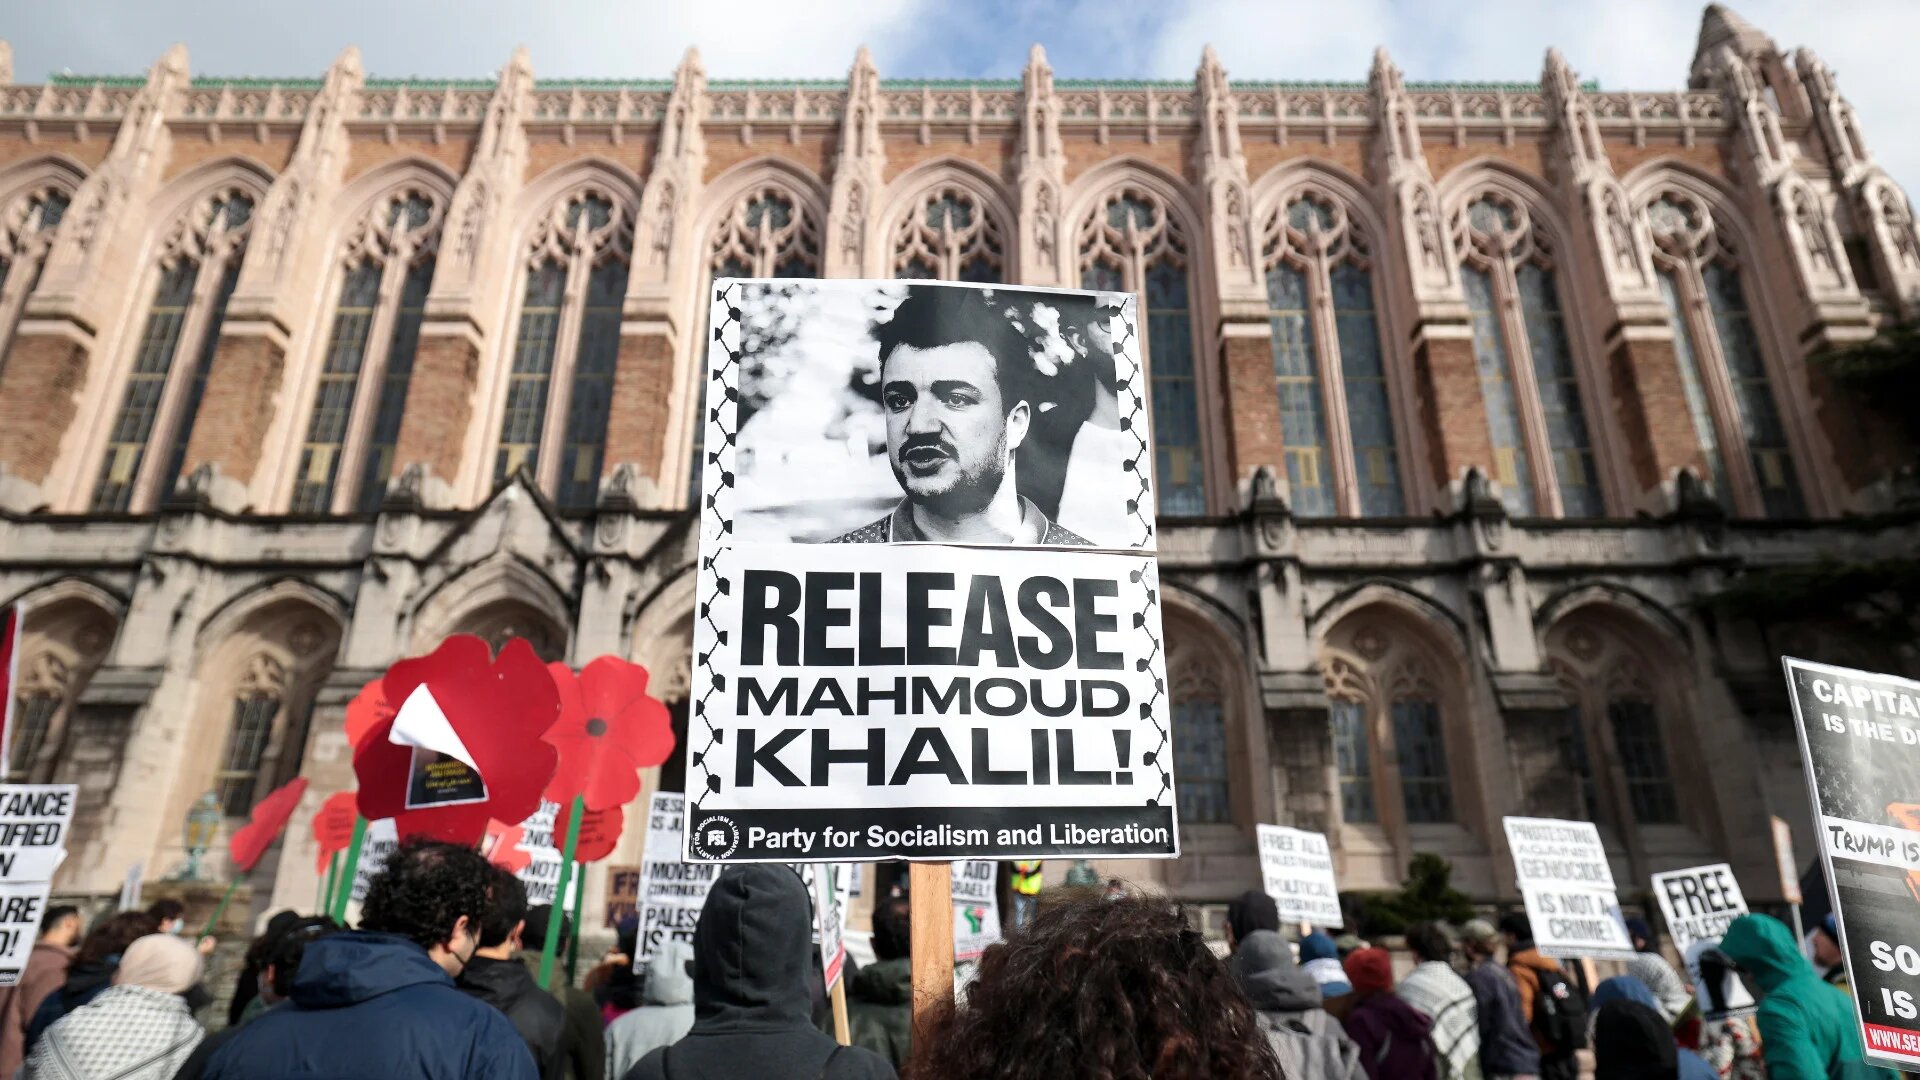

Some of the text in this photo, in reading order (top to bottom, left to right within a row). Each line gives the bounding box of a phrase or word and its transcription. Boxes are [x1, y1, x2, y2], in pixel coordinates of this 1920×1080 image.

[740, 569, 1125, 670] RELEASE
[736, 676, 1131, 718] MAHMOUD
[1812, 679, 1920, 718] CAPITA
[1822, 713, 1846, 734] IS
[1848, 718, 1896, 742] THE
[735, 726, 1133, 787] KHALIL!
[707, 830, 728, 846] PSL
[748, 822, 1168, 853] Party for Socialism and Liberation
[1828, 825, 1920, 862] TRUMP IS
[964, 861, 990, 880] AID
[647, 883, 705, 897] CONTINUES
[1537, 891, 1556, 914] IS
[1560, 893, 1595, 914] NOT
[1662, 871, 1737, 918] FREE
[1881, 988, 1918, 1019] IS
[1869, 1028, 1920, 1053] WWW.SE
